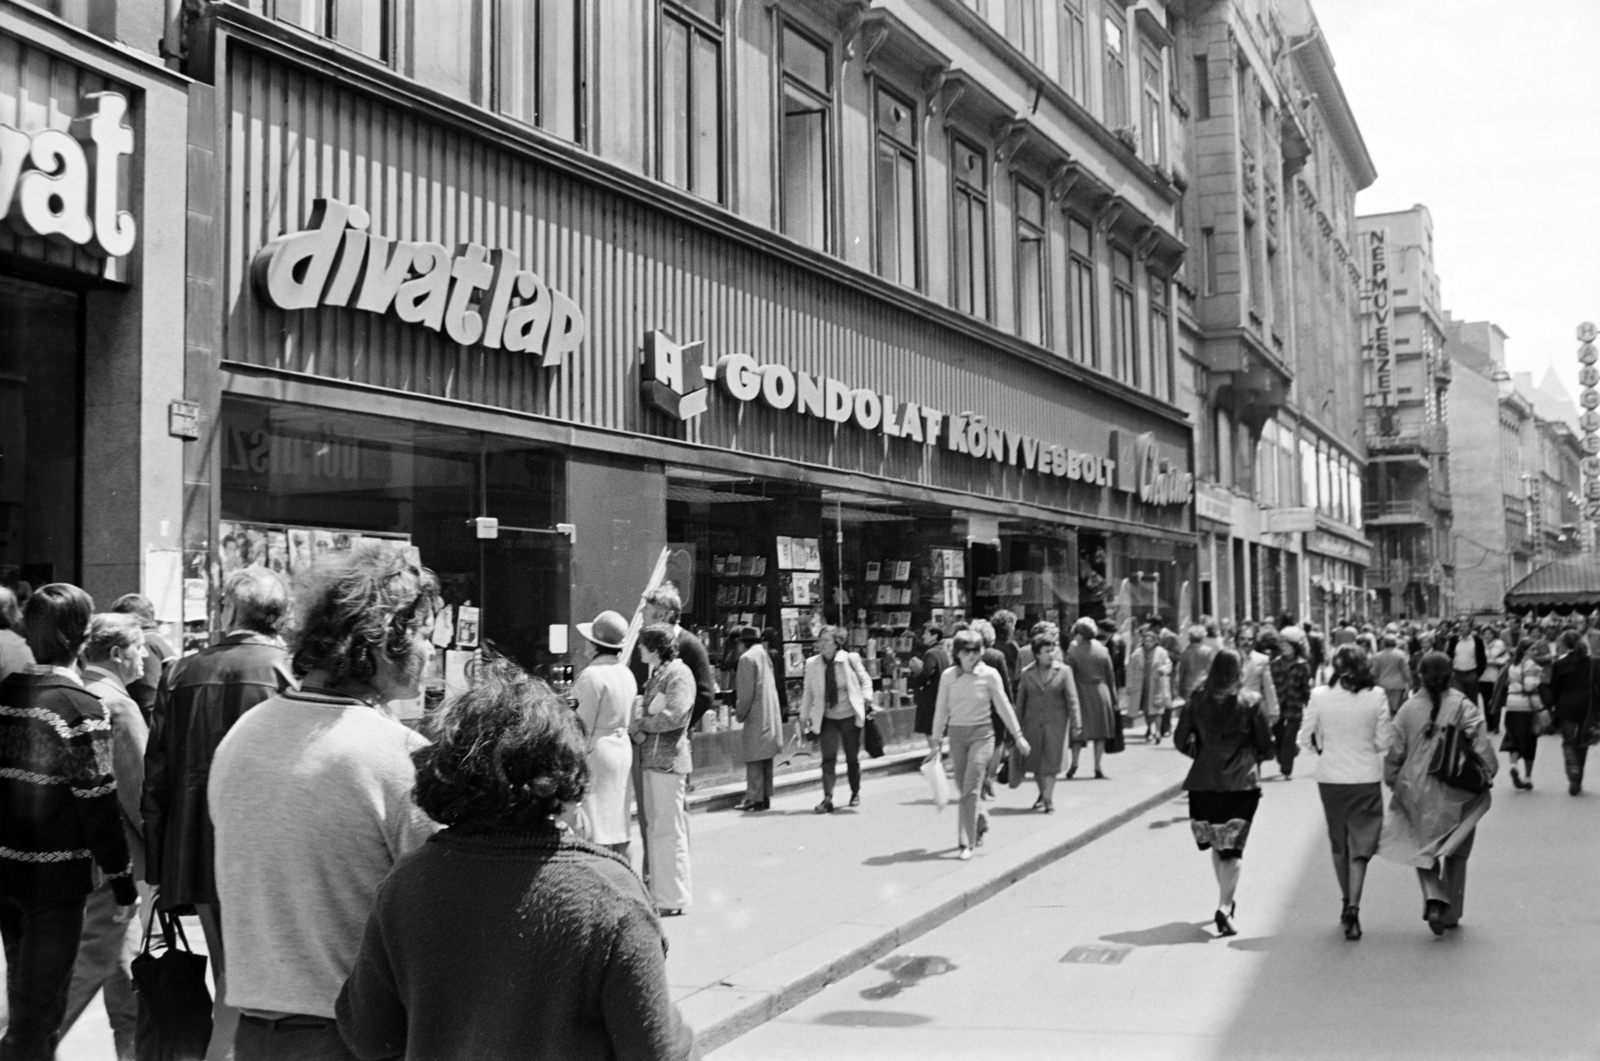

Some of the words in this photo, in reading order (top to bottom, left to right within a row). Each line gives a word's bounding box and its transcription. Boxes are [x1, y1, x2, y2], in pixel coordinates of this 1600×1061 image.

[262, 197, 585, 368] divatlap
[722, 353, 942, 445] GONDOLAT
[945, 410, 1117, 487] KÖNYVESBOLT
[1579, 323, 1600, 518] HANGLEMEZ
